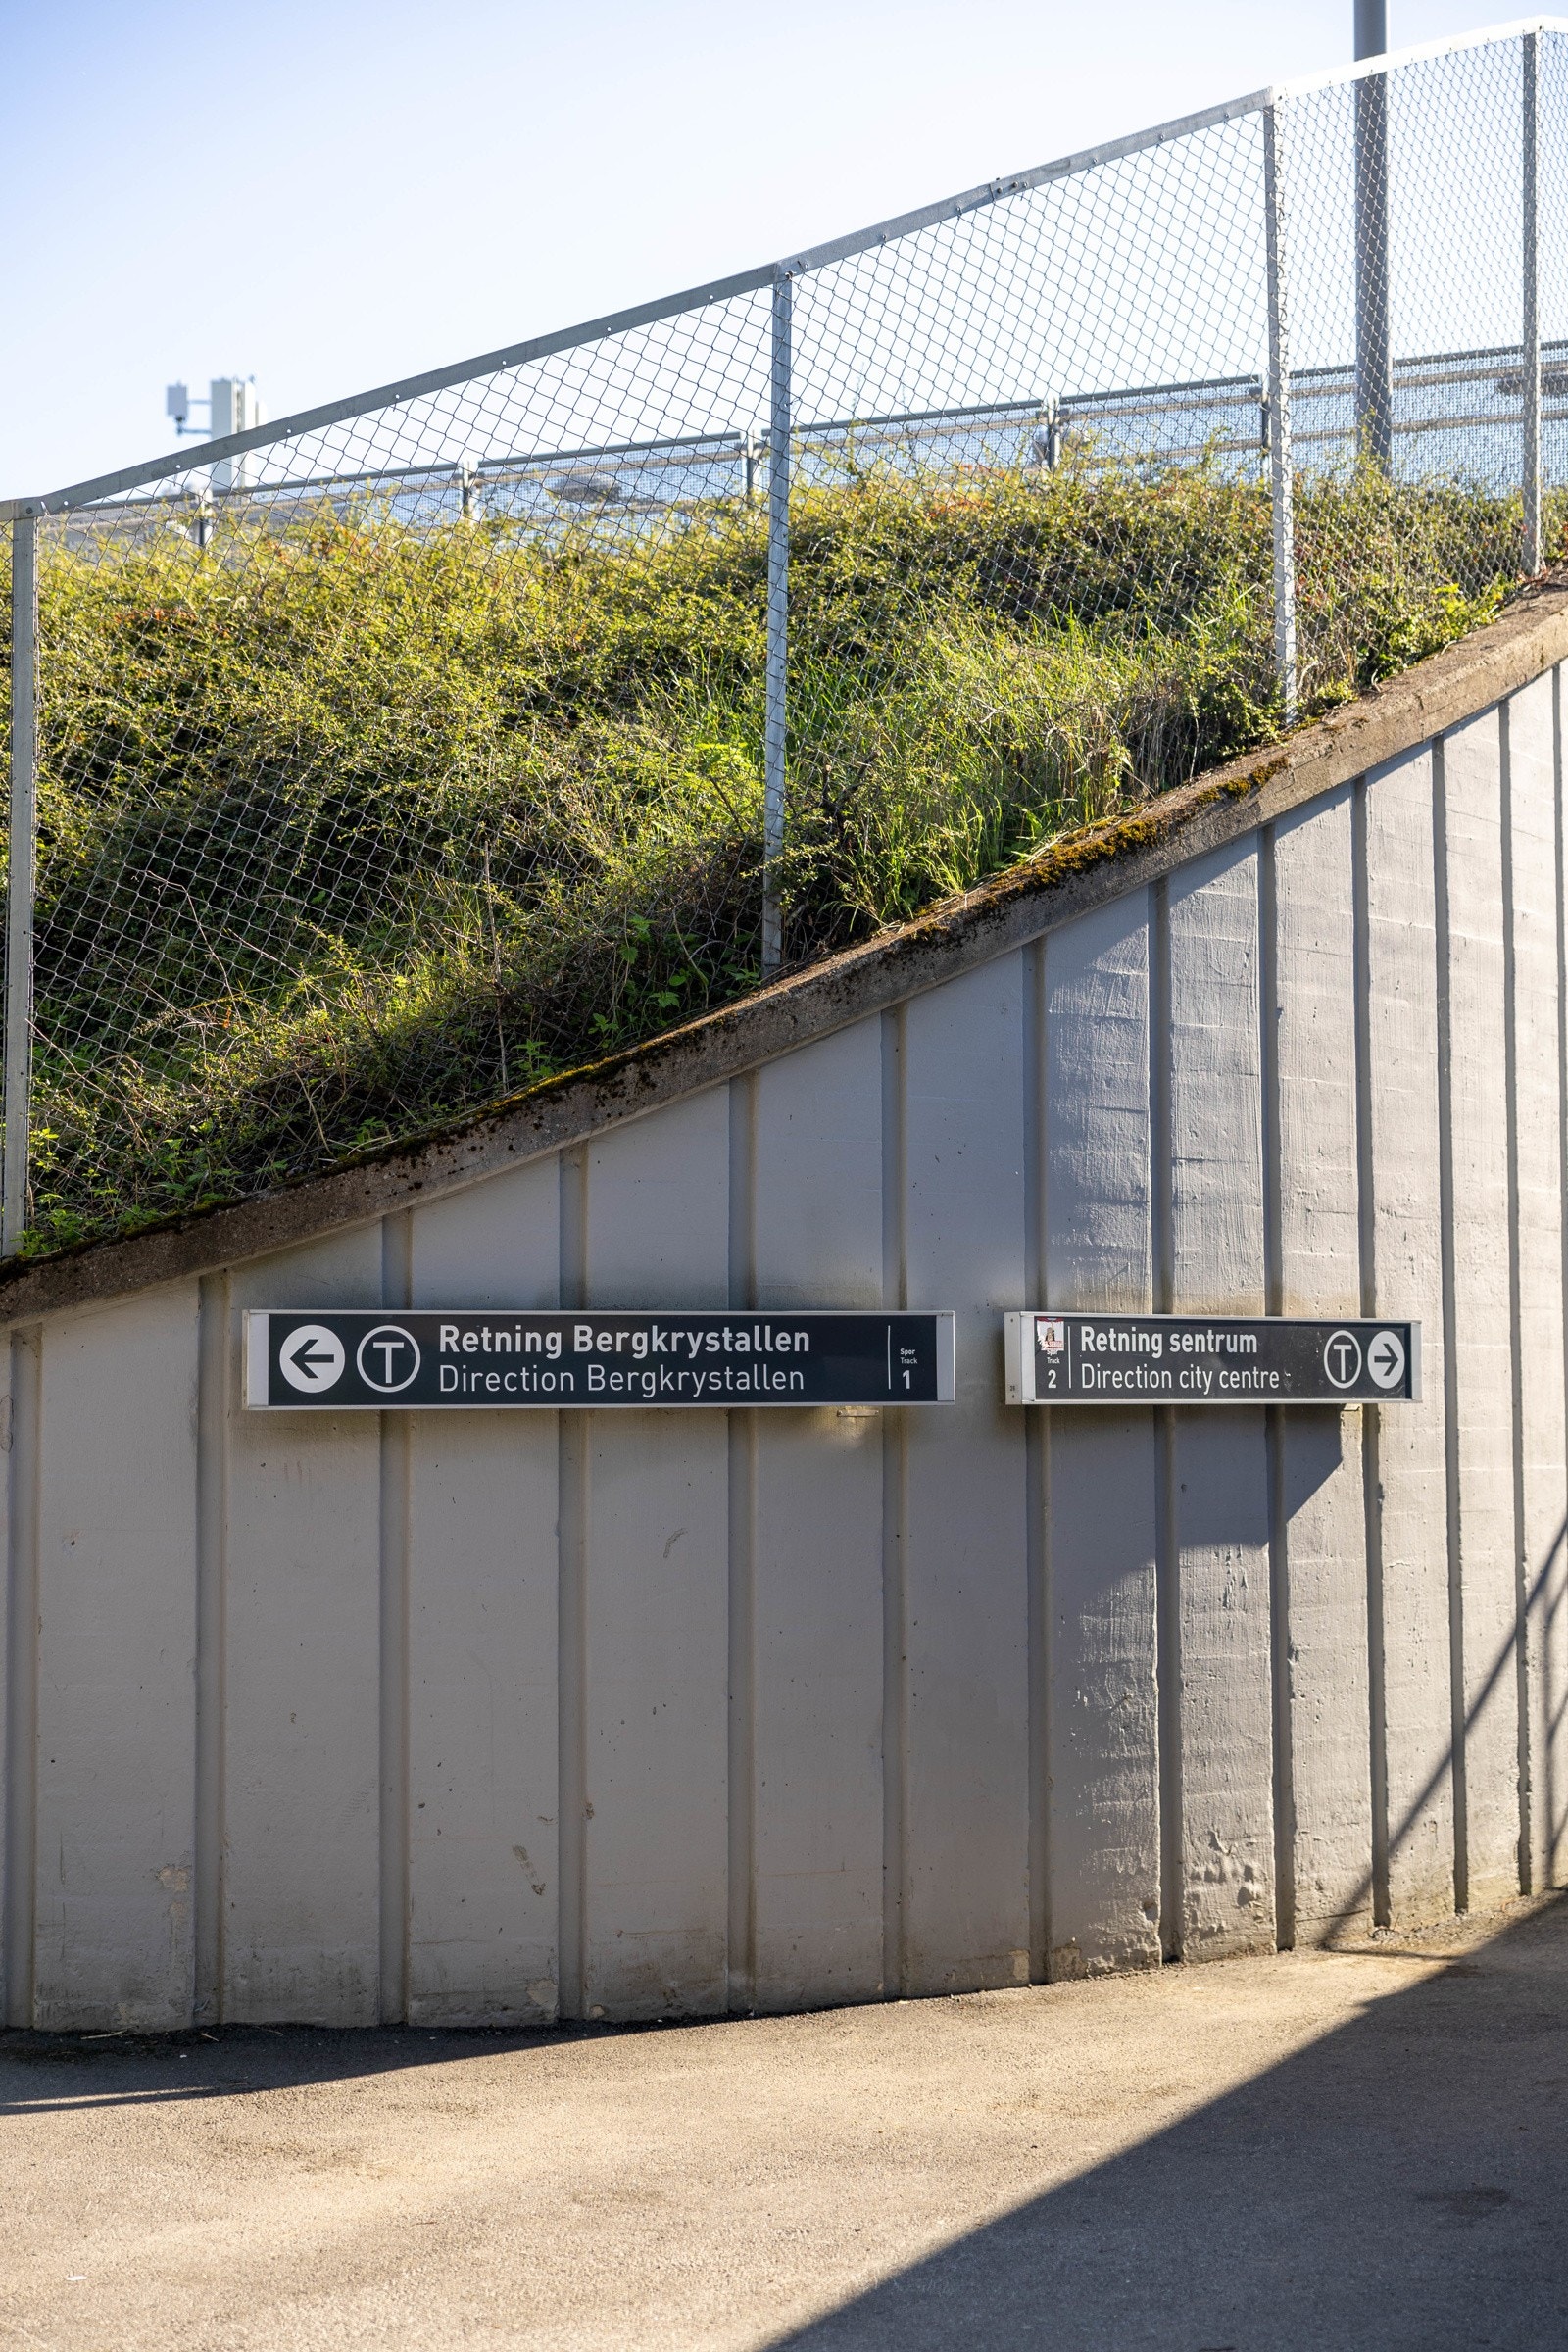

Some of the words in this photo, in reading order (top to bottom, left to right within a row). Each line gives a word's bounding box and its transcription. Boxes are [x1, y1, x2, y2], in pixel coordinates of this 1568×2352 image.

[439, 1324, 562, 1360] Retning
[573, 1324, 809, 1359] Bergkrystallen
[900, 1348, 916, 1356] Spor
[1080, 1325, 1163, 1359] Retning
[1169, 1329, 1258, 1353] sentrum
[372, 1341, 405, 1384] T
[902, 1369, 910, 1390] 1
[1047, 1368, 1057, 1389] 2
[1081, 1362, 1172, 1389] Direction
[1179, 1363, 1213, 1396] city
[1218, 1366, 1280, 1389] centre
[1333, 1344, 1352, 1382] T
[439, 1364, 574, 1392] Direction
[587, 1363, 804, 1398] Bergkrystallen
